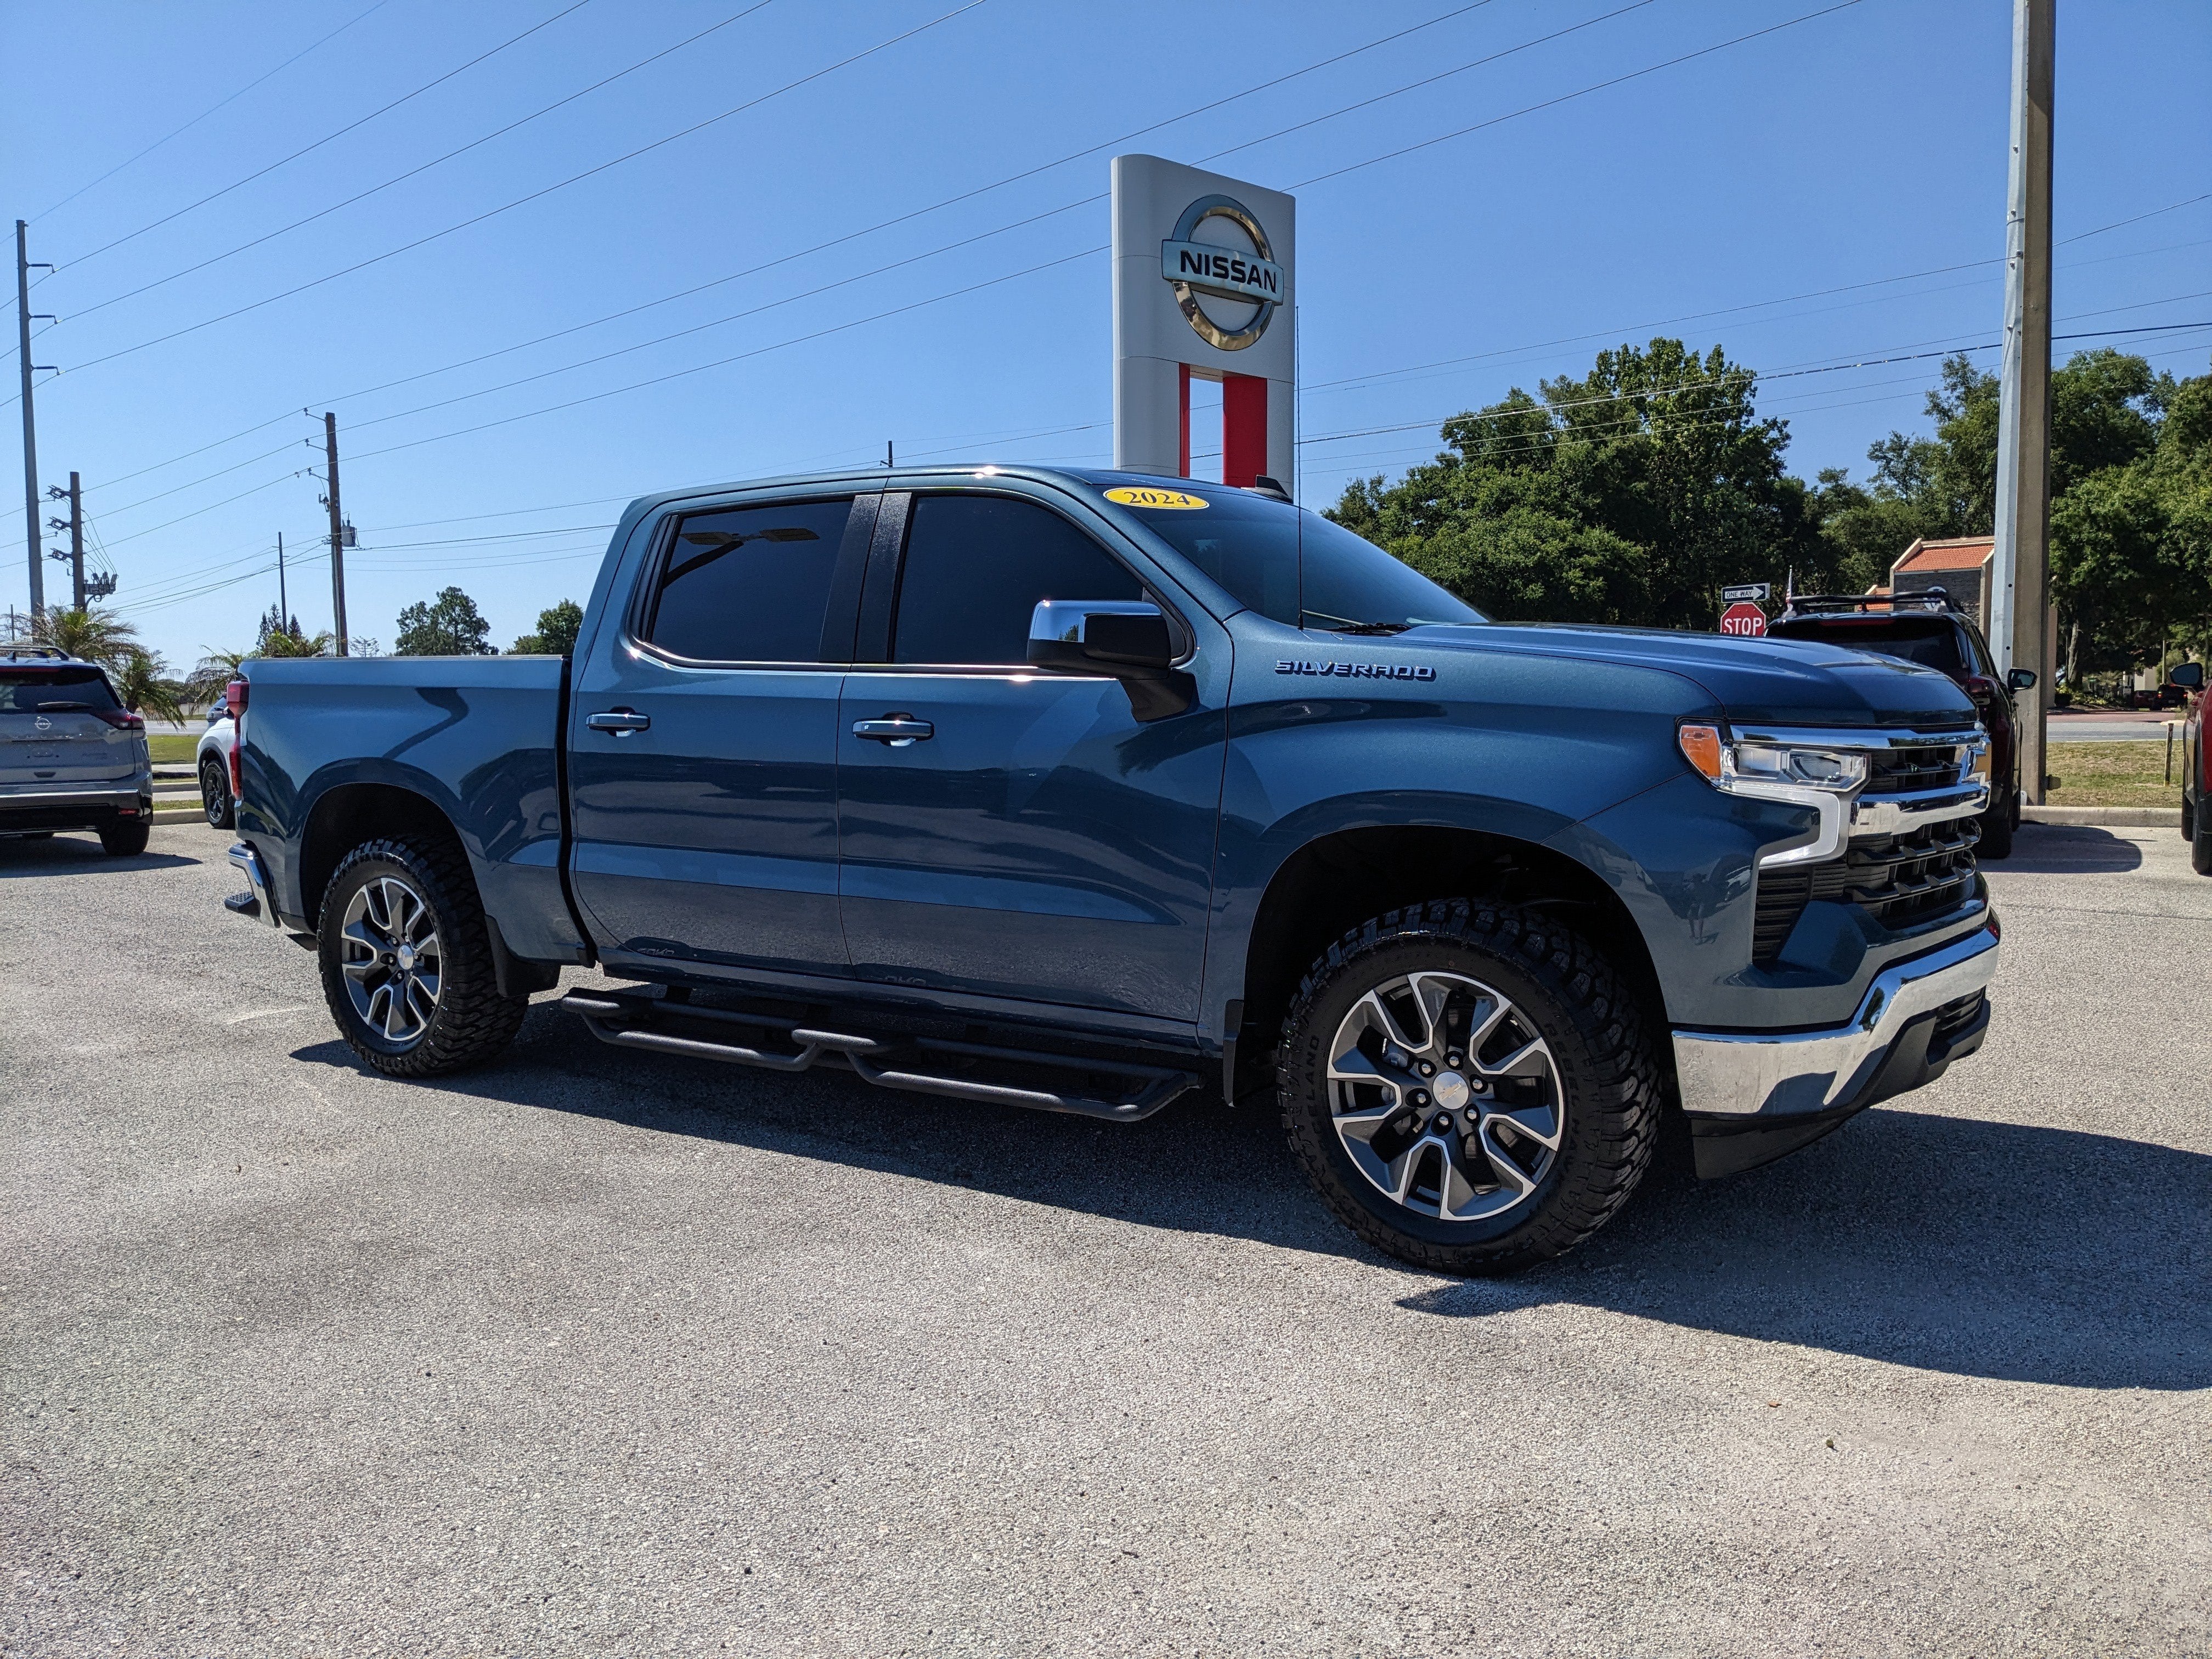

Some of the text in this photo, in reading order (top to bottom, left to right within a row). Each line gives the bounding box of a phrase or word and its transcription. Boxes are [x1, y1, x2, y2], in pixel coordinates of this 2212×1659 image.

[1180, 250, 1277, 294] NISSAN
[1124, 492, 1190, 505] 2024
[1724, 617, 1763, 636] STOP
[1275, 660, 1435, 681] SILVERADO
